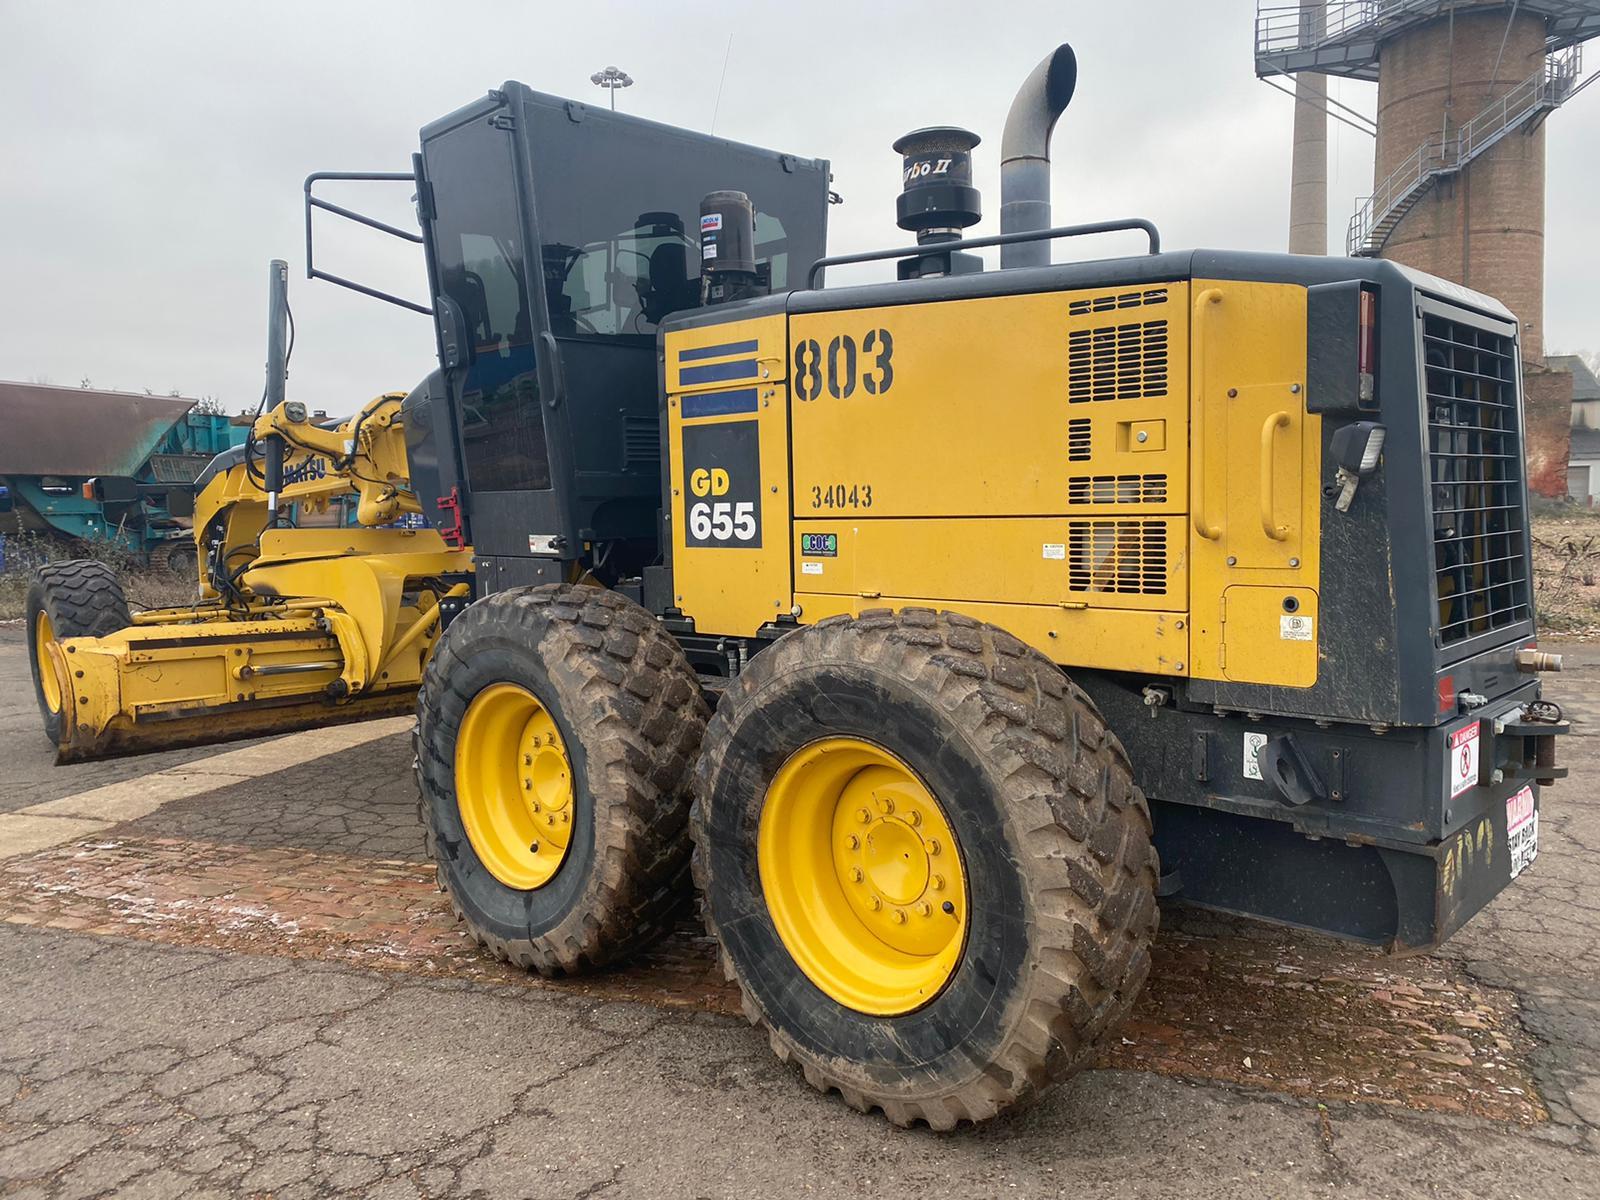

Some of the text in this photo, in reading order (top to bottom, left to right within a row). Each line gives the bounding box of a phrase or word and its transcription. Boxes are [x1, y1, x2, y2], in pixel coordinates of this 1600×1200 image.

[795, 328, 893, 402] 803
[284, 458, 325, 484] MATSU
[690, 468, 730, 497] GD
[812, 484, 872, 509] 34043
[690, 502, 756, 541] 655
